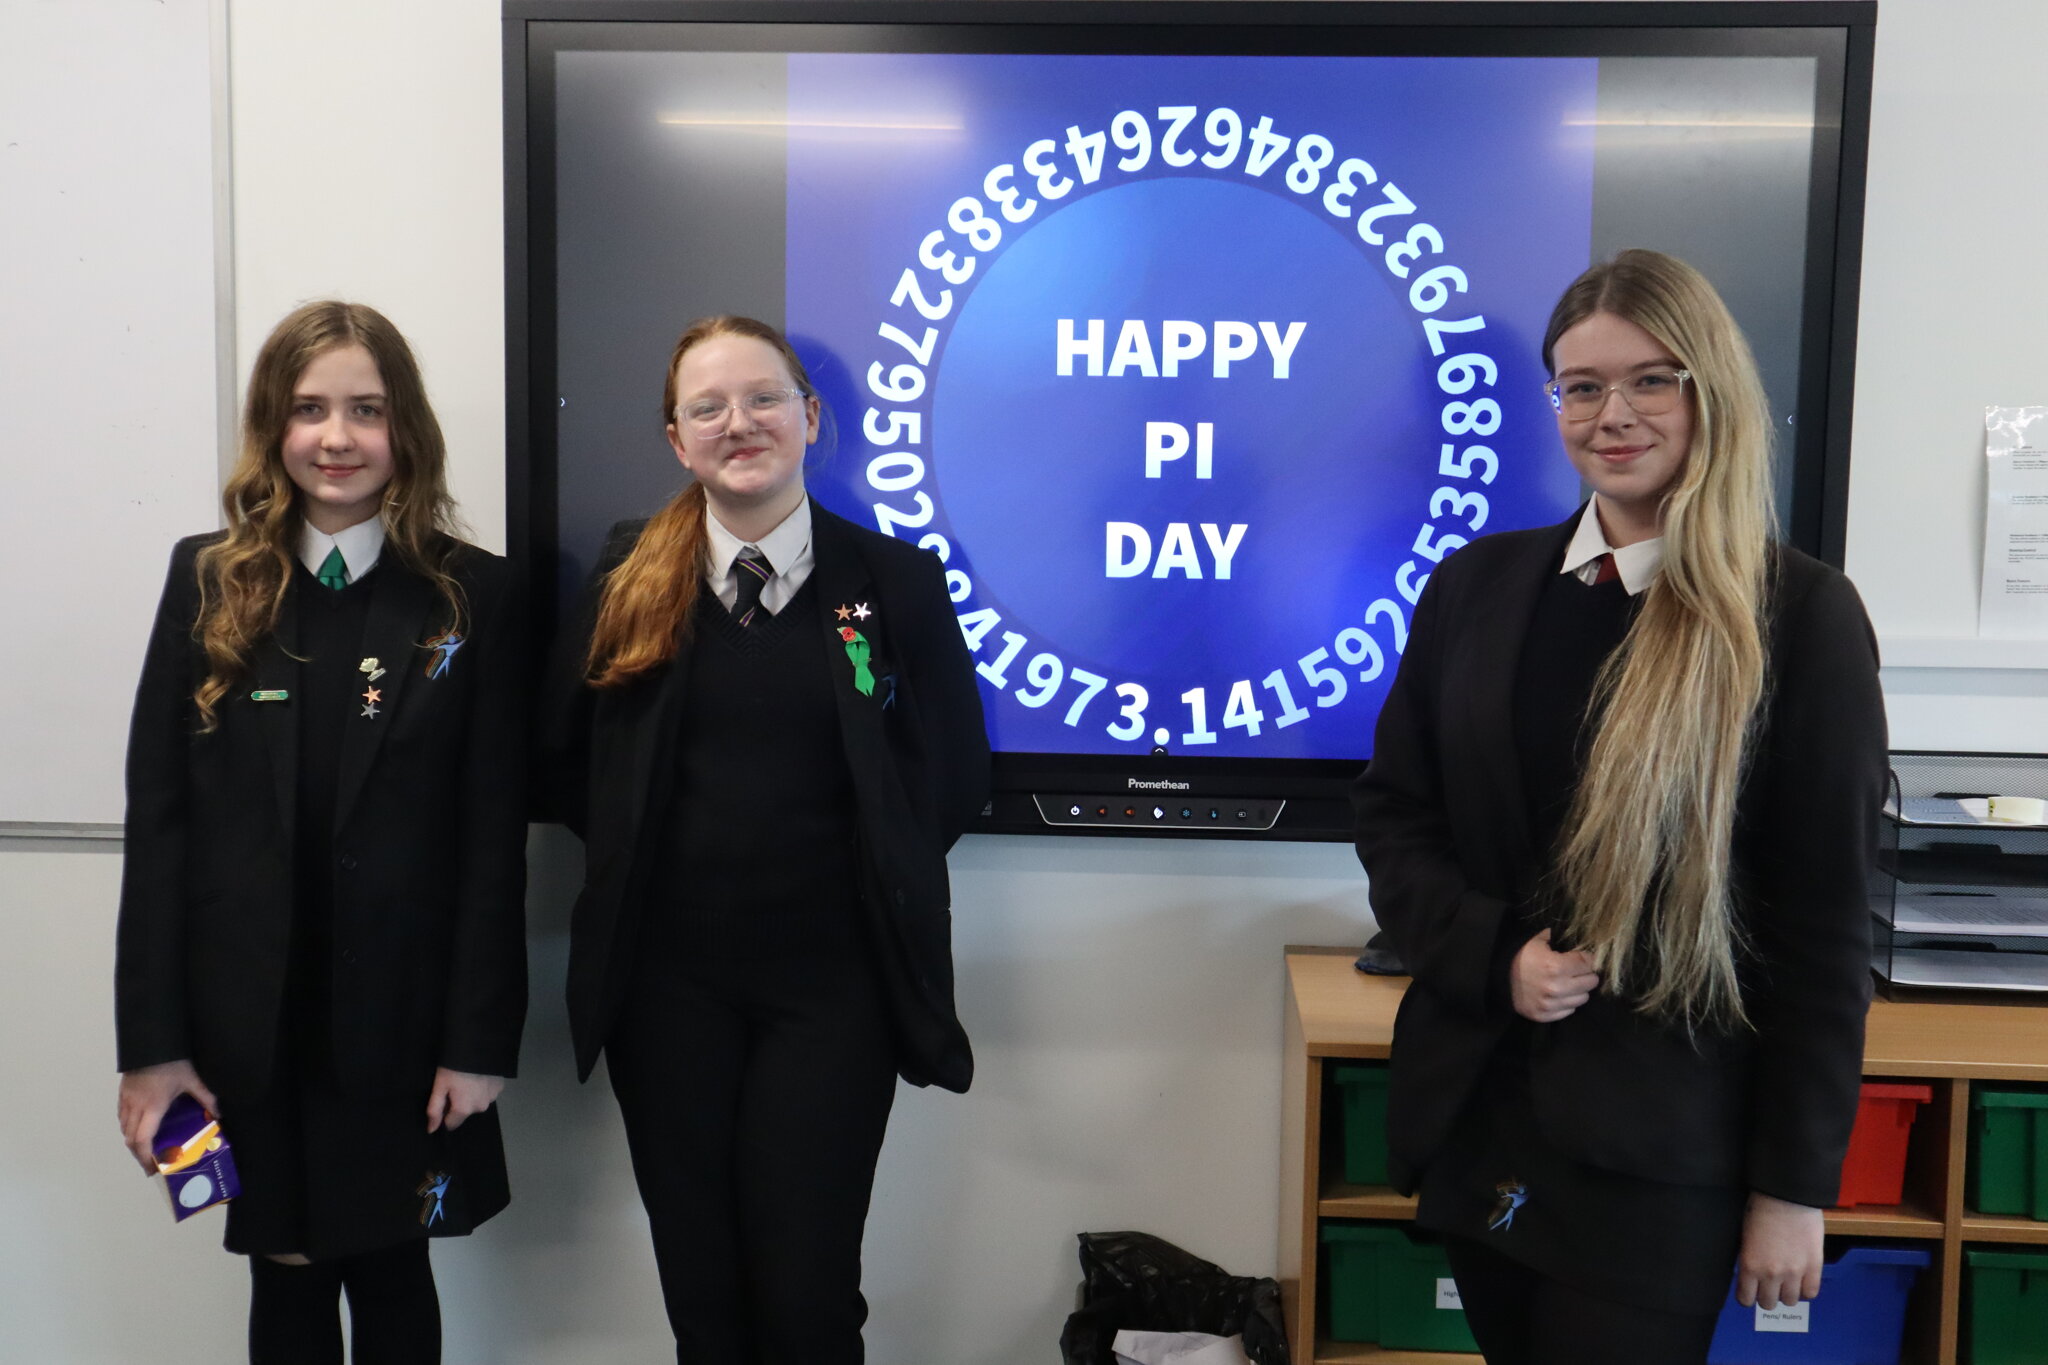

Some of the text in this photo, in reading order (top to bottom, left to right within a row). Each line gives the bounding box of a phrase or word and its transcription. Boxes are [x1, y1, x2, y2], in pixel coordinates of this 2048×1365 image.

[1056, 319, 1307, 378] HAPPY
[1145, 421, 1214, 479] PI
[1105, 522, 1249, 580] DAY
[1127, 777, 1190, 790] Promethean
